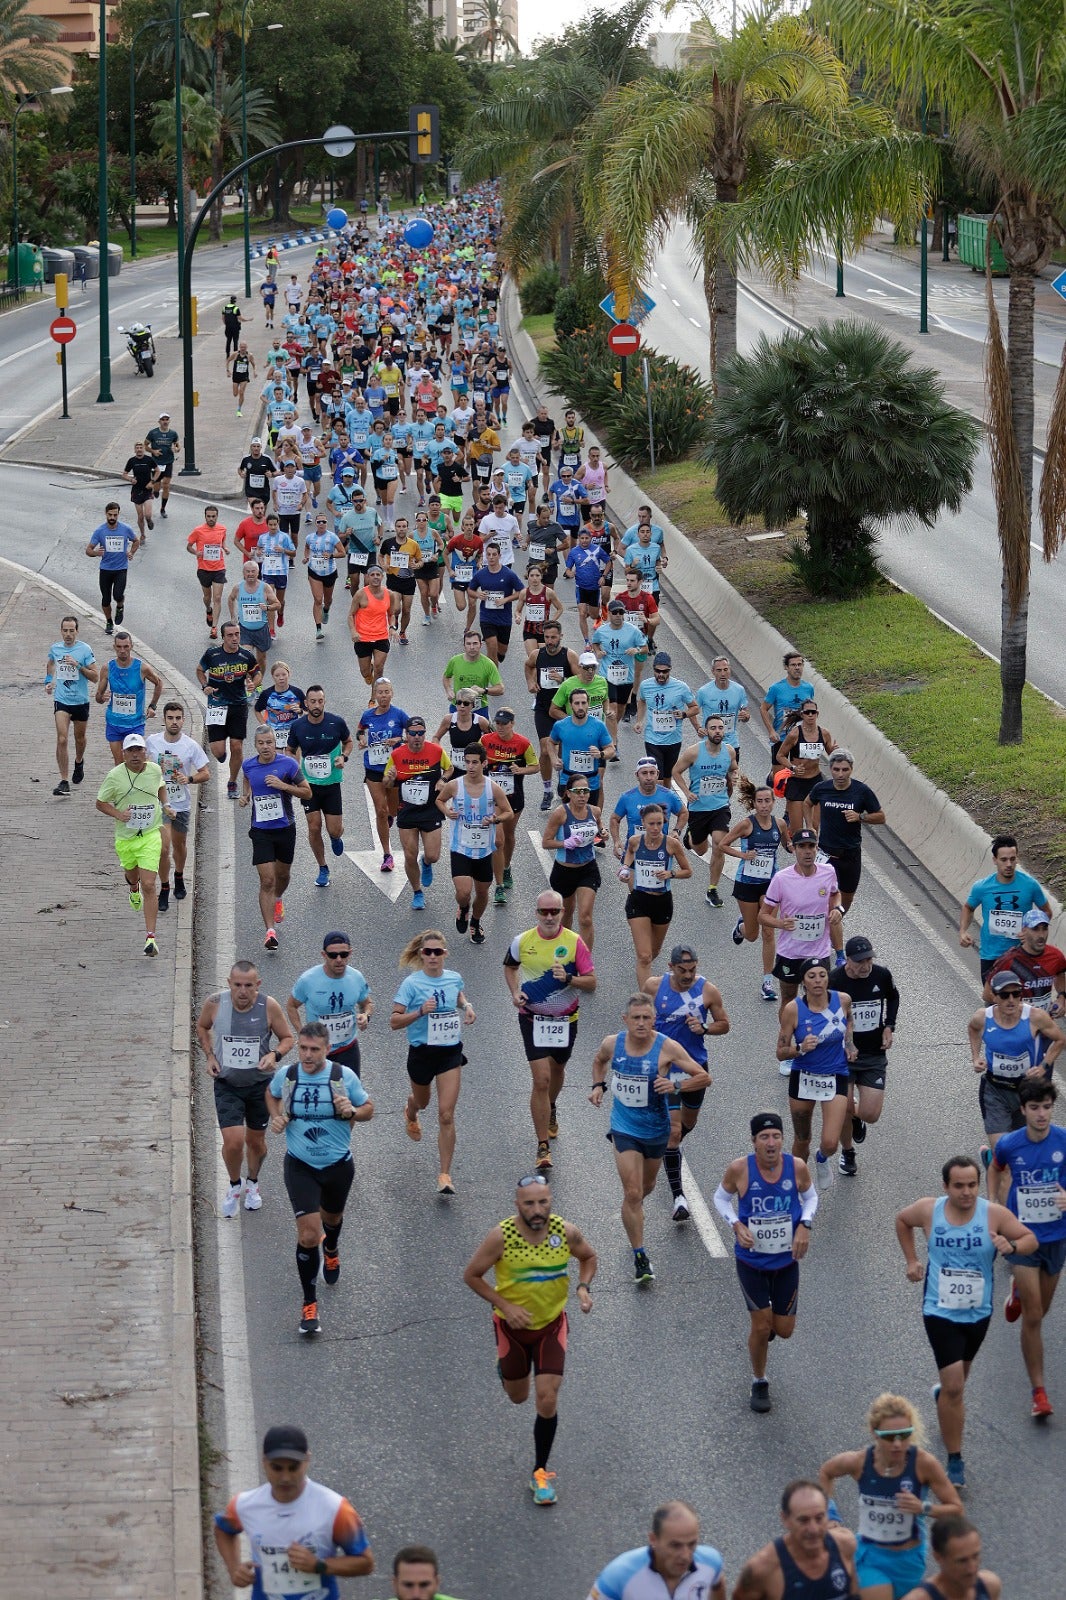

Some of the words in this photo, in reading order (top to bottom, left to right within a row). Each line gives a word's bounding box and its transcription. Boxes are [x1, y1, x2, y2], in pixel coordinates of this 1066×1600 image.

[408, 788, 422, 796] 177
[259, 802, 277, 811] 3496
[824, 801, 854, 810] mayoral
[132, 812, 152, 820] 3365
[471, 832, 481, 840] 35
[750, 859, 770, 868] 6807
[799, 922, 820, 930] 3241
[995, 918, 1017, 928] 6592
[853, 1010, 877, 1020] 1180
[431, 1021, 459, 1031] 11546
[540, 1025, 564, 1034] 1128
[231, 1048, 251, 1057] 202
[1000, 1062, 1024, 1071] 6691
[802, 1078, 834, 1089] 11534
[616, 1083, 642, 1095] 6161
[1020, 1167, 1059, 1184] RCM
[752, 1195, 791, 1212] RCM
[1025, 1197, 1055, 1208] 6056
[756, 1227, 786, 1240] 6055
[935, 1232, 983, 1251] nerja
[950, 1283, 973, 1295] 203
[868, 1510, 905, 1524] 6993
